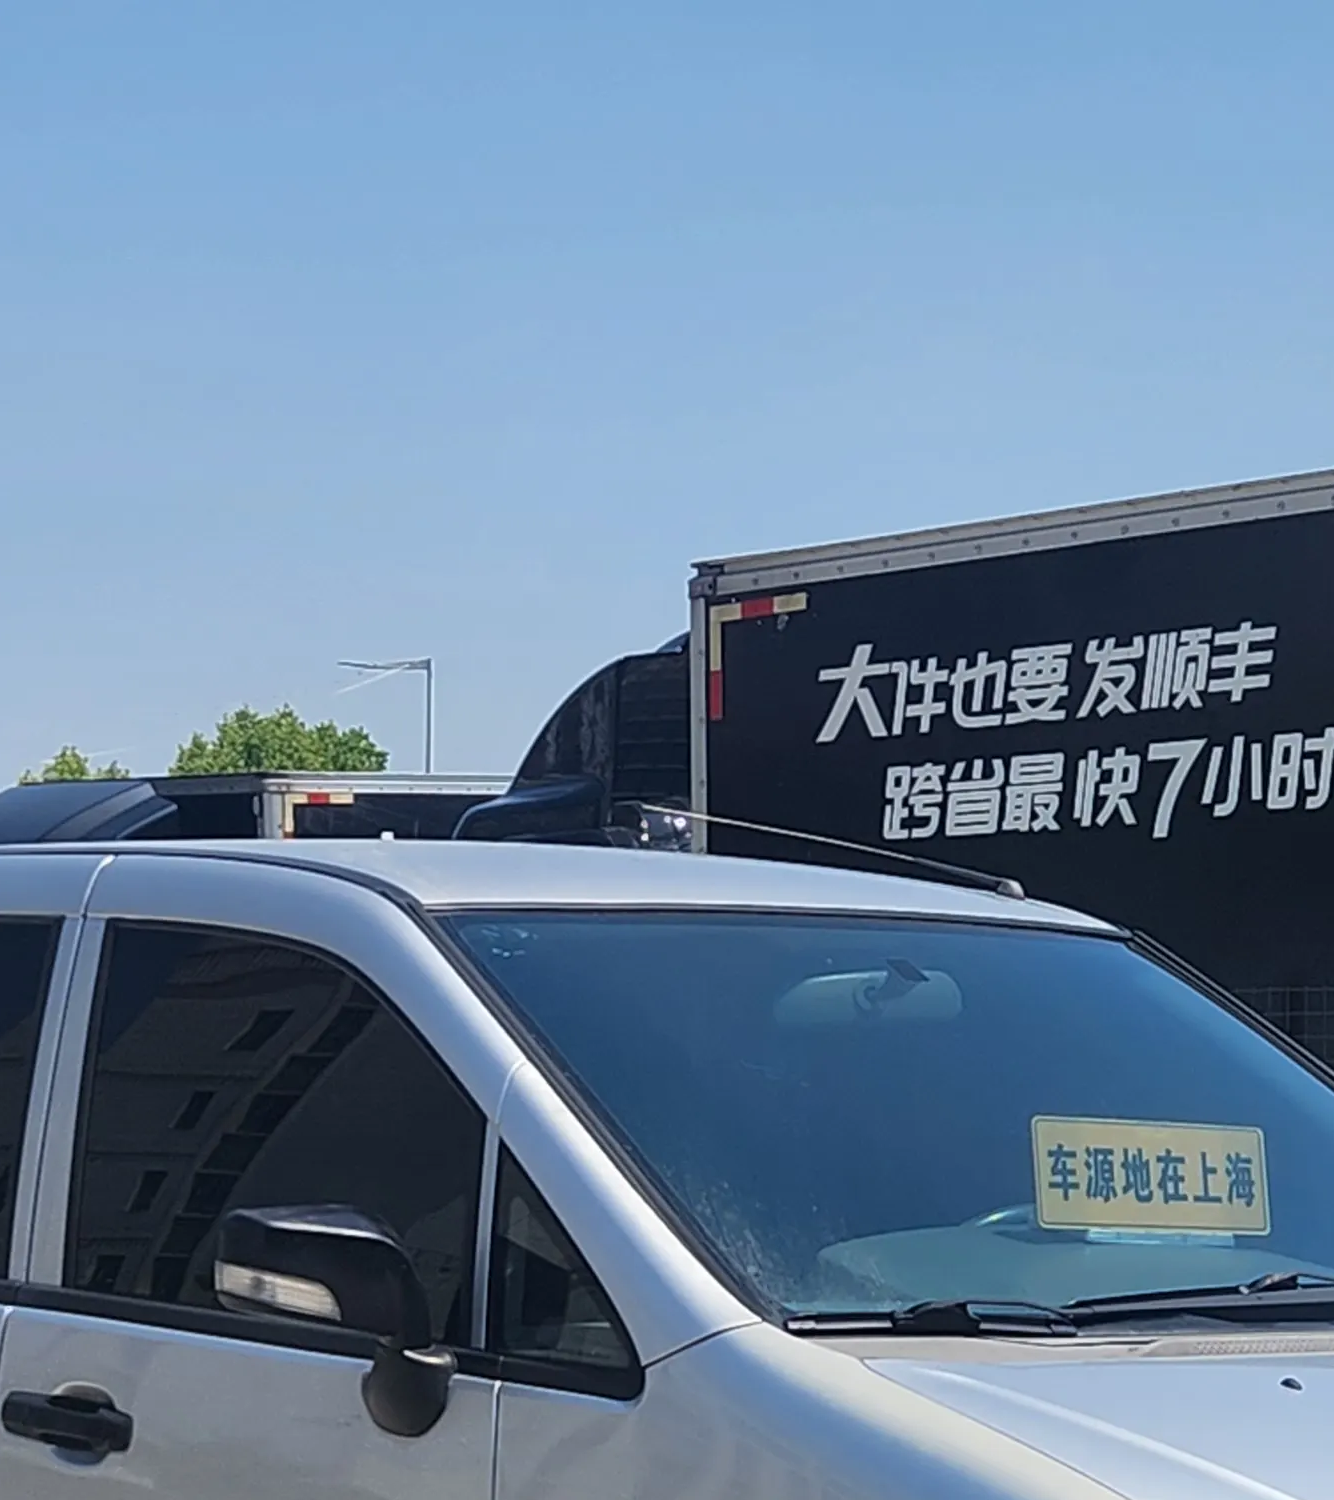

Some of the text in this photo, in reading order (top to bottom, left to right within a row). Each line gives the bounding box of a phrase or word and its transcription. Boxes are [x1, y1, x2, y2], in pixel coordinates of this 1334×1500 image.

[815, 620, 1278, 744] 大件也要发顺丰
[1046, 1143, 1256, 1208] 车源地在上海
